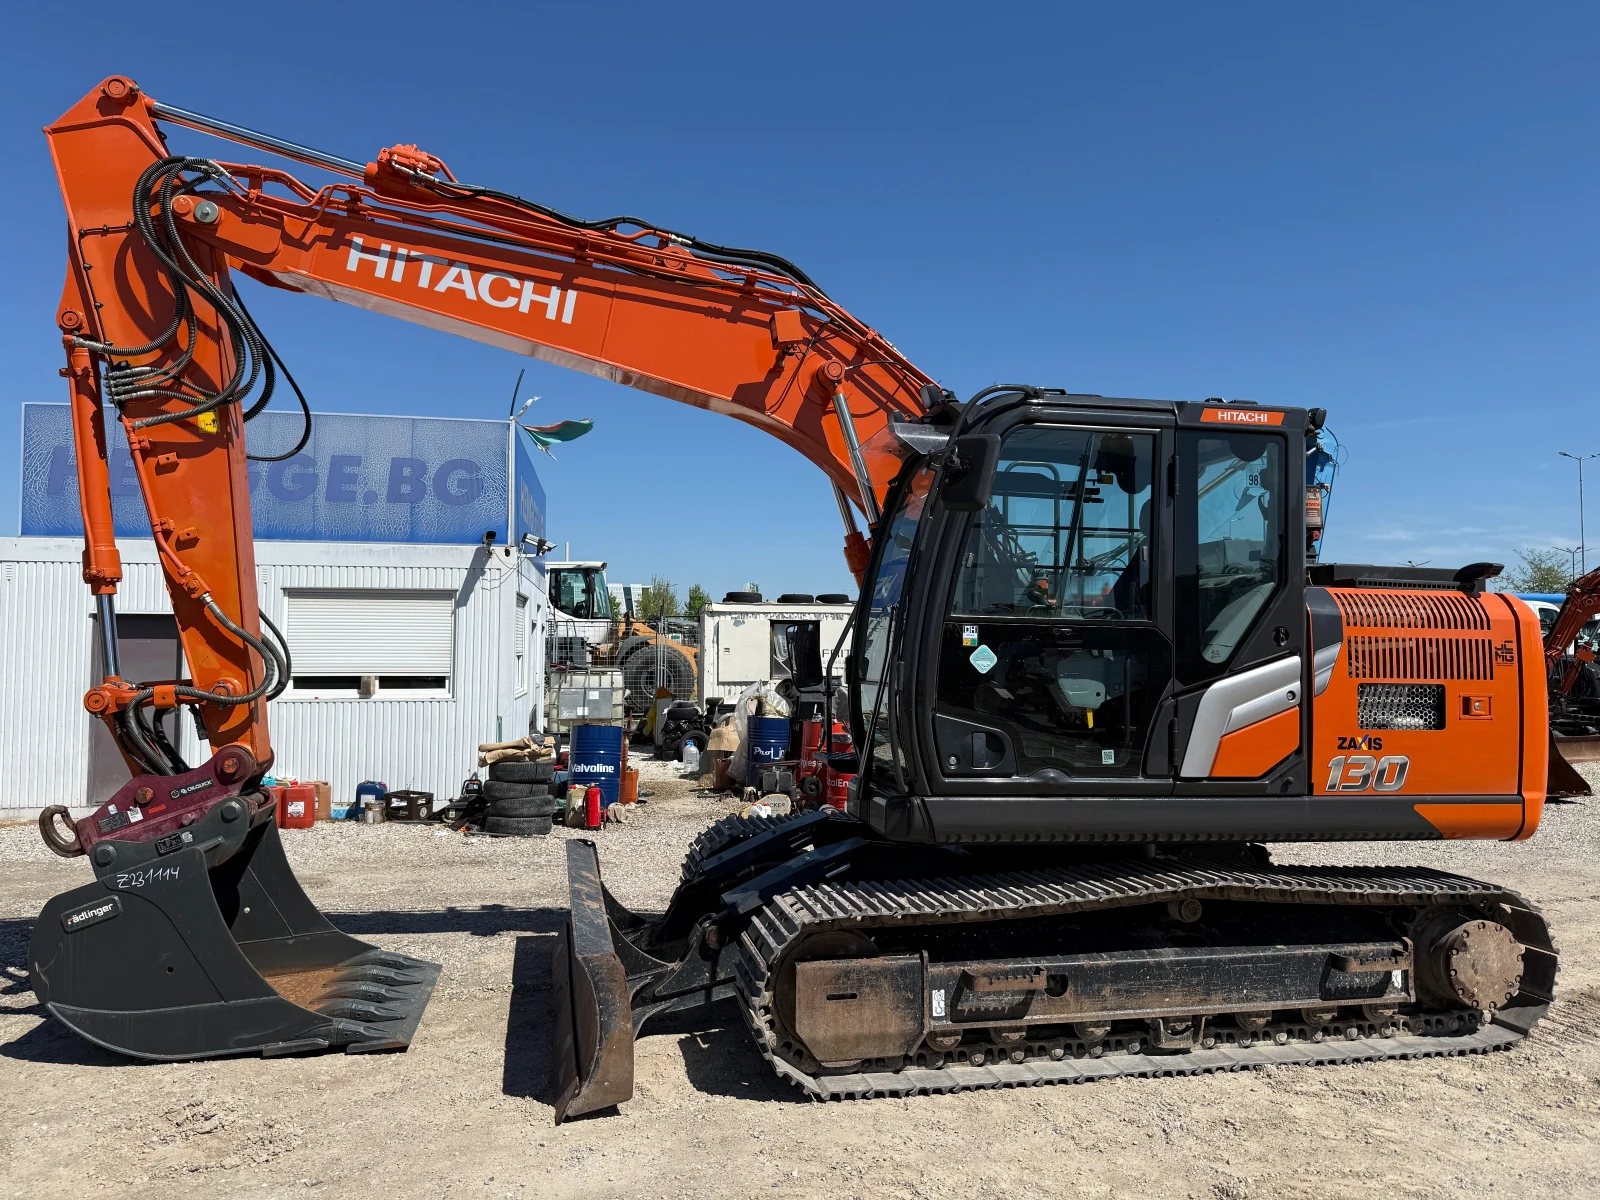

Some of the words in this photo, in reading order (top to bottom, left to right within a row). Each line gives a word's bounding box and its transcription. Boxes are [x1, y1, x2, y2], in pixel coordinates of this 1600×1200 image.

[346, 236, 577, 325] HITACHI
[1218, 411, 1268, 423] HITACHI
[1337, 734, 1383, 750] ZAXIS
[571, 763, 615, 773] Valvoline
[1325, 755, 1410, 792] 130
[117, 866, 180, 888] Z231114
[67, 903, 114, 925] rädlinger
